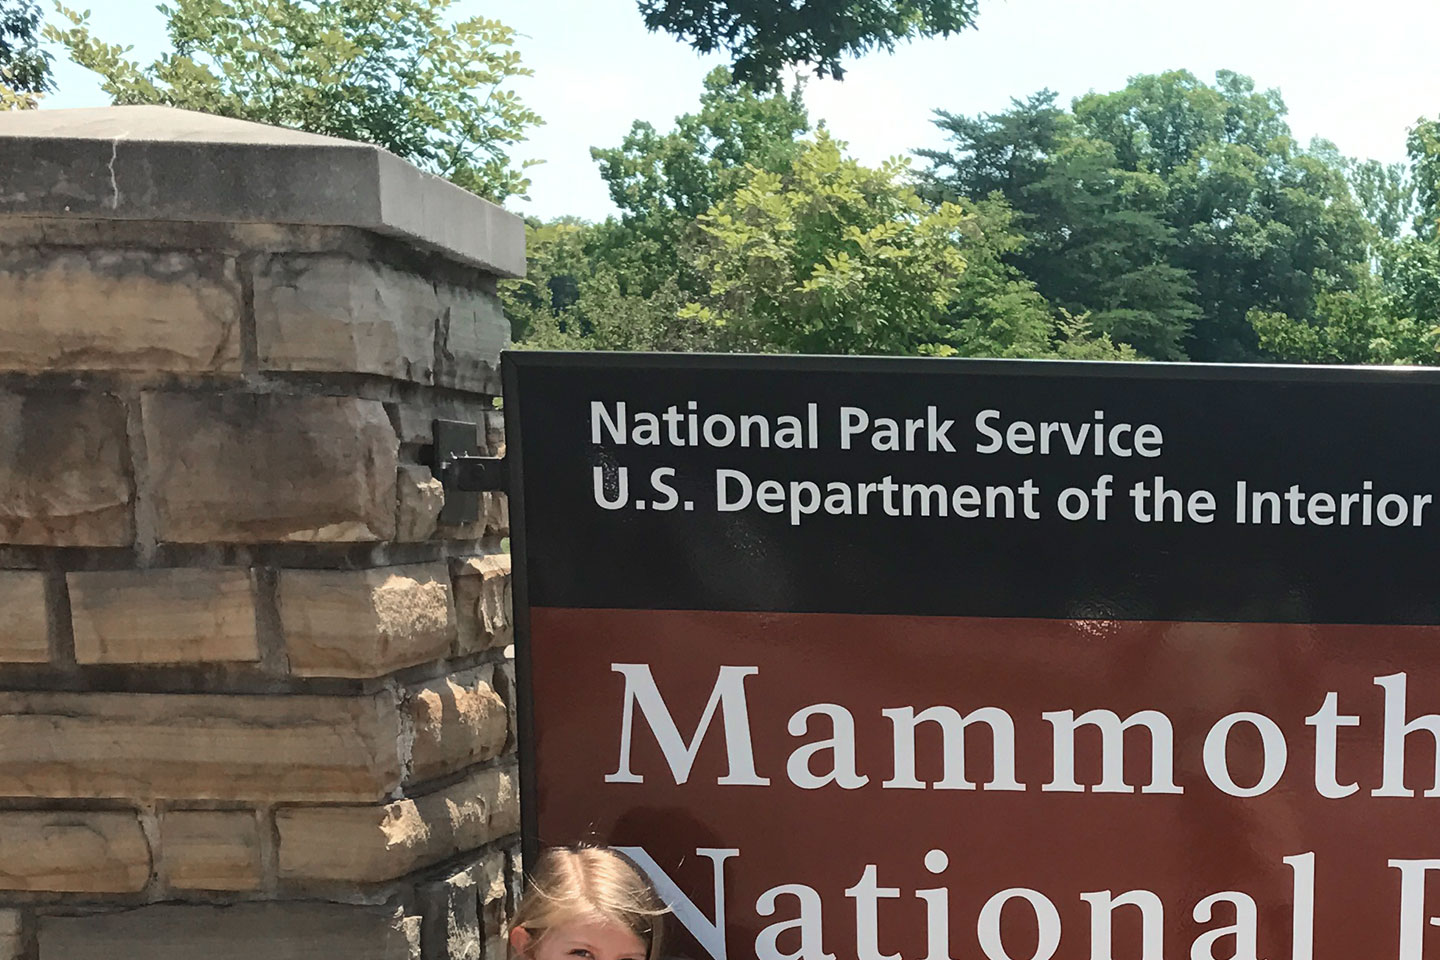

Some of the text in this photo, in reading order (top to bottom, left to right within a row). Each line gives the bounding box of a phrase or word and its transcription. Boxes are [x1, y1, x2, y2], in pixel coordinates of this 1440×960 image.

[590, 400, 1164, 458] National Park Service
[592, 466, 1433, 527] U.S. Department of the Interior
